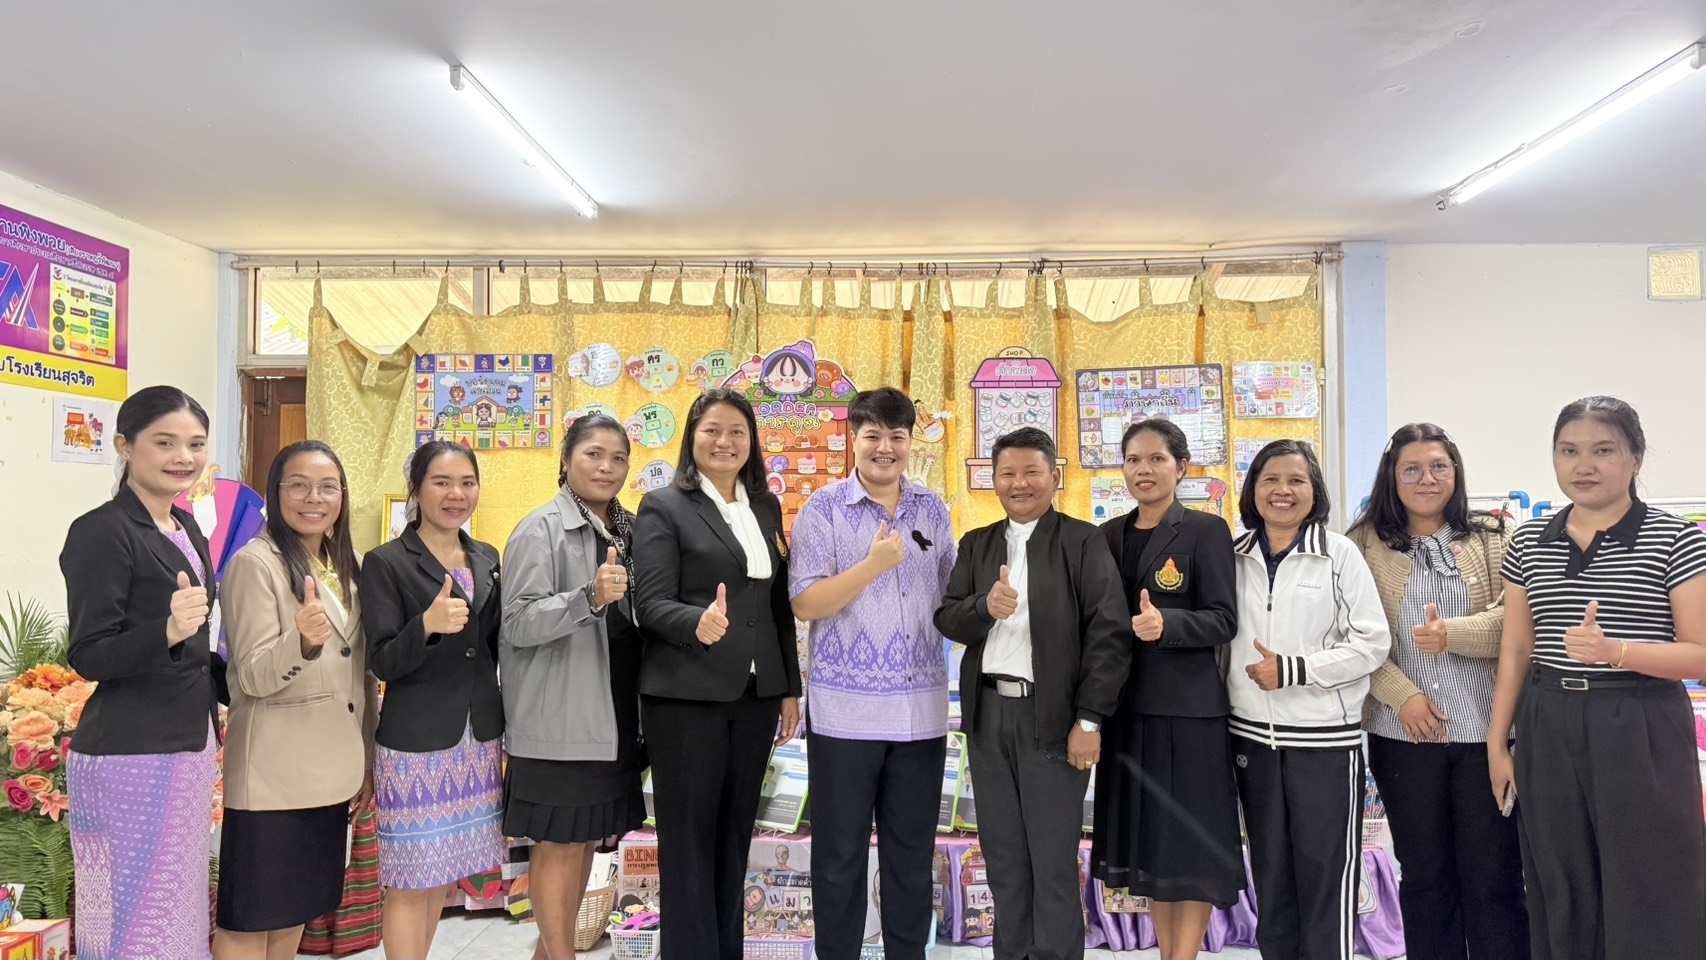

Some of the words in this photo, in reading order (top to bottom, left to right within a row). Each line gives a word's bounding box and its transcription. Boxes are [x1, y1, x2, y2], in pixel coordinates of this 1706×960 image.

[711, 358, 724, 367] กว
[1124, 391, 1178, 408] ภาษาถิ่น
[758, 401, 817, 416] ORDER
[650, 466, 663, 478] ปล
[624, 849, 658, 861] BIN
